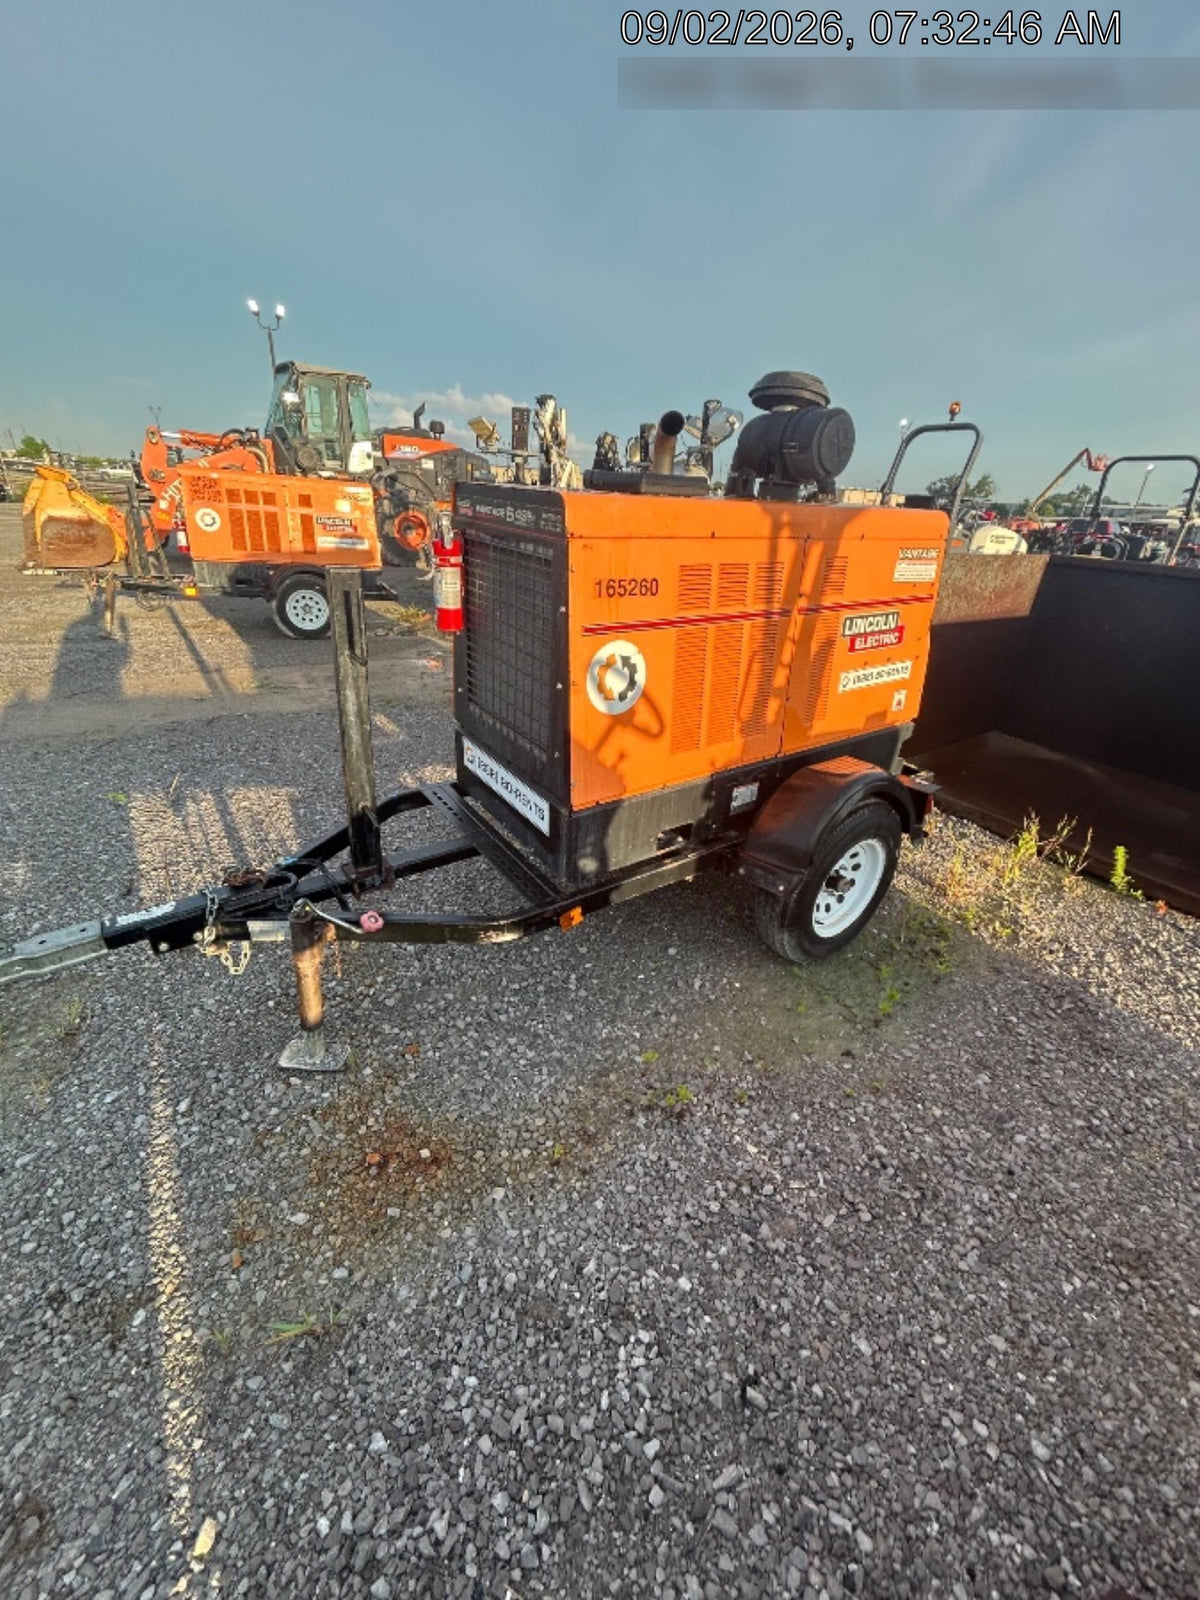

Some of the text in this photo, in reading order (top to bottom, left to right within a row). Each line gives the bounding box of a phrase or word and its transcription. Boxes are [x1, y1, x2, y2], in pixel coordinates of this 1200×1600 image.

[595, 578, 659, 598] 165260
[844, 613, 898, 636] LINCOLN
[854, 632, 899, 650] ELECTRIC
